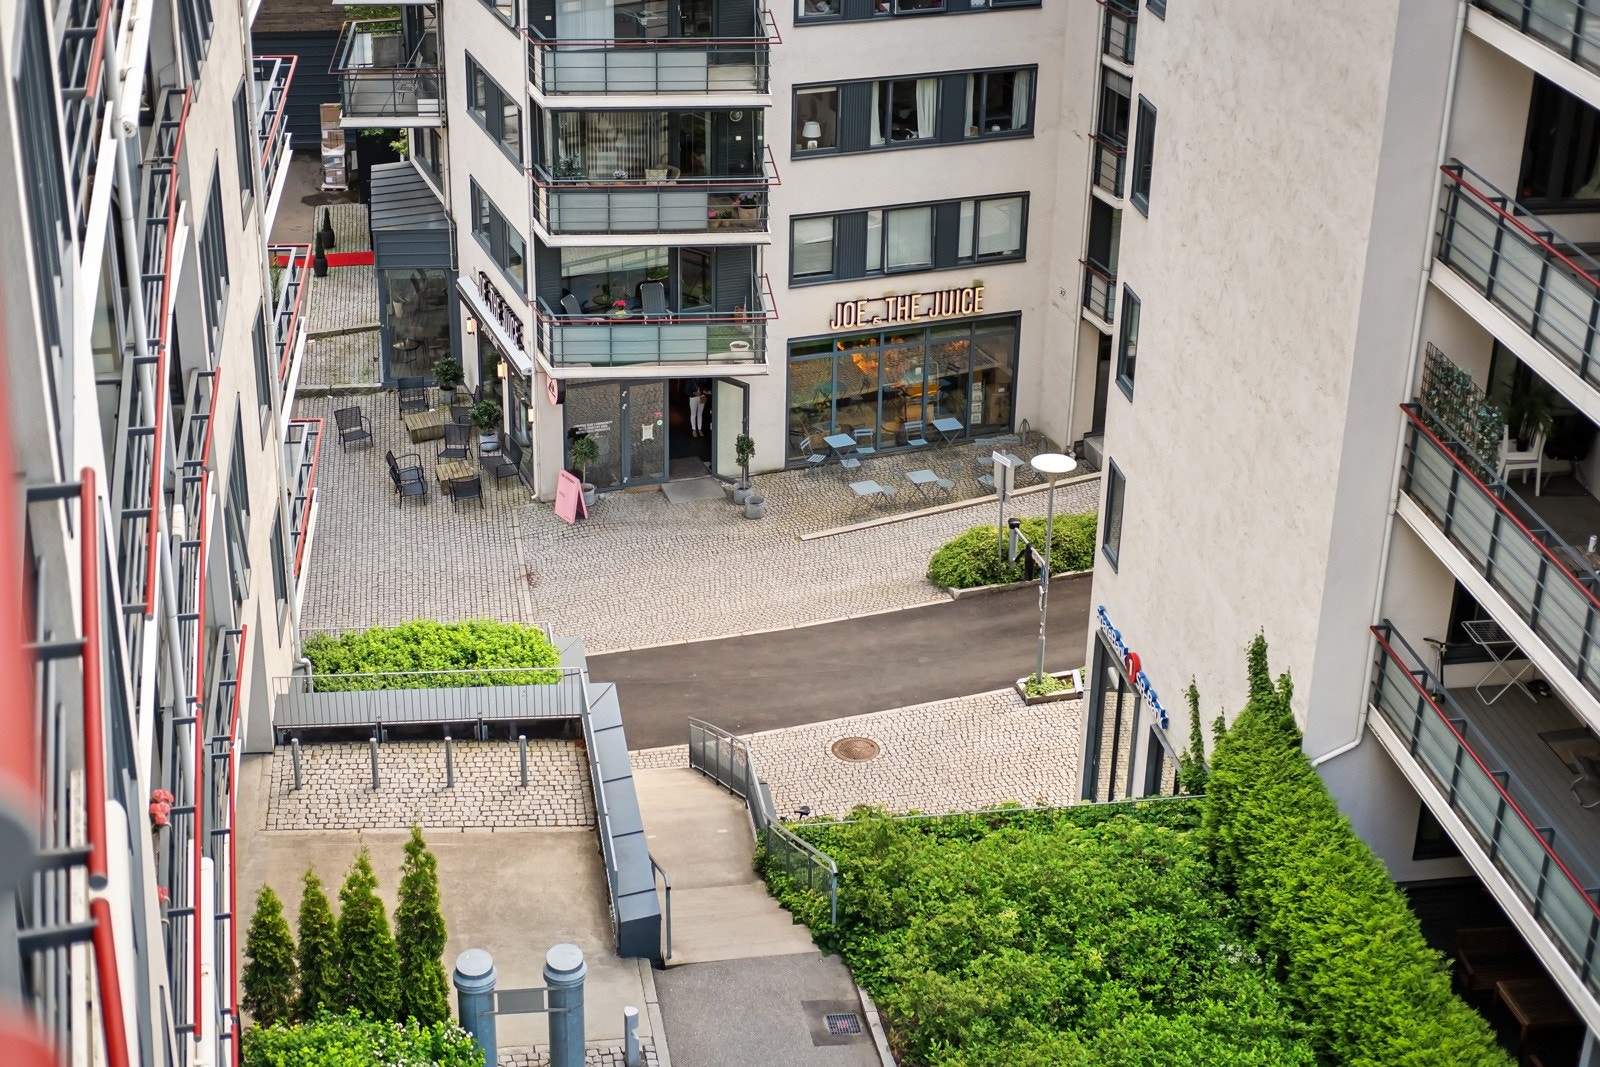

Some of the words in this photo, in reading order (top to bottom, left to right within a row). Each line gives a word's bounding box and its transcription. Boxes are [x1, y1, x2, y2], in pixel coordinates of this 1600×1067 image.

[830, 300, 868, 330] JOE
[872, 316, 882, 326] &
[885, 294, 922, 323] THE
[929, 287, 985, 319] JUICE
